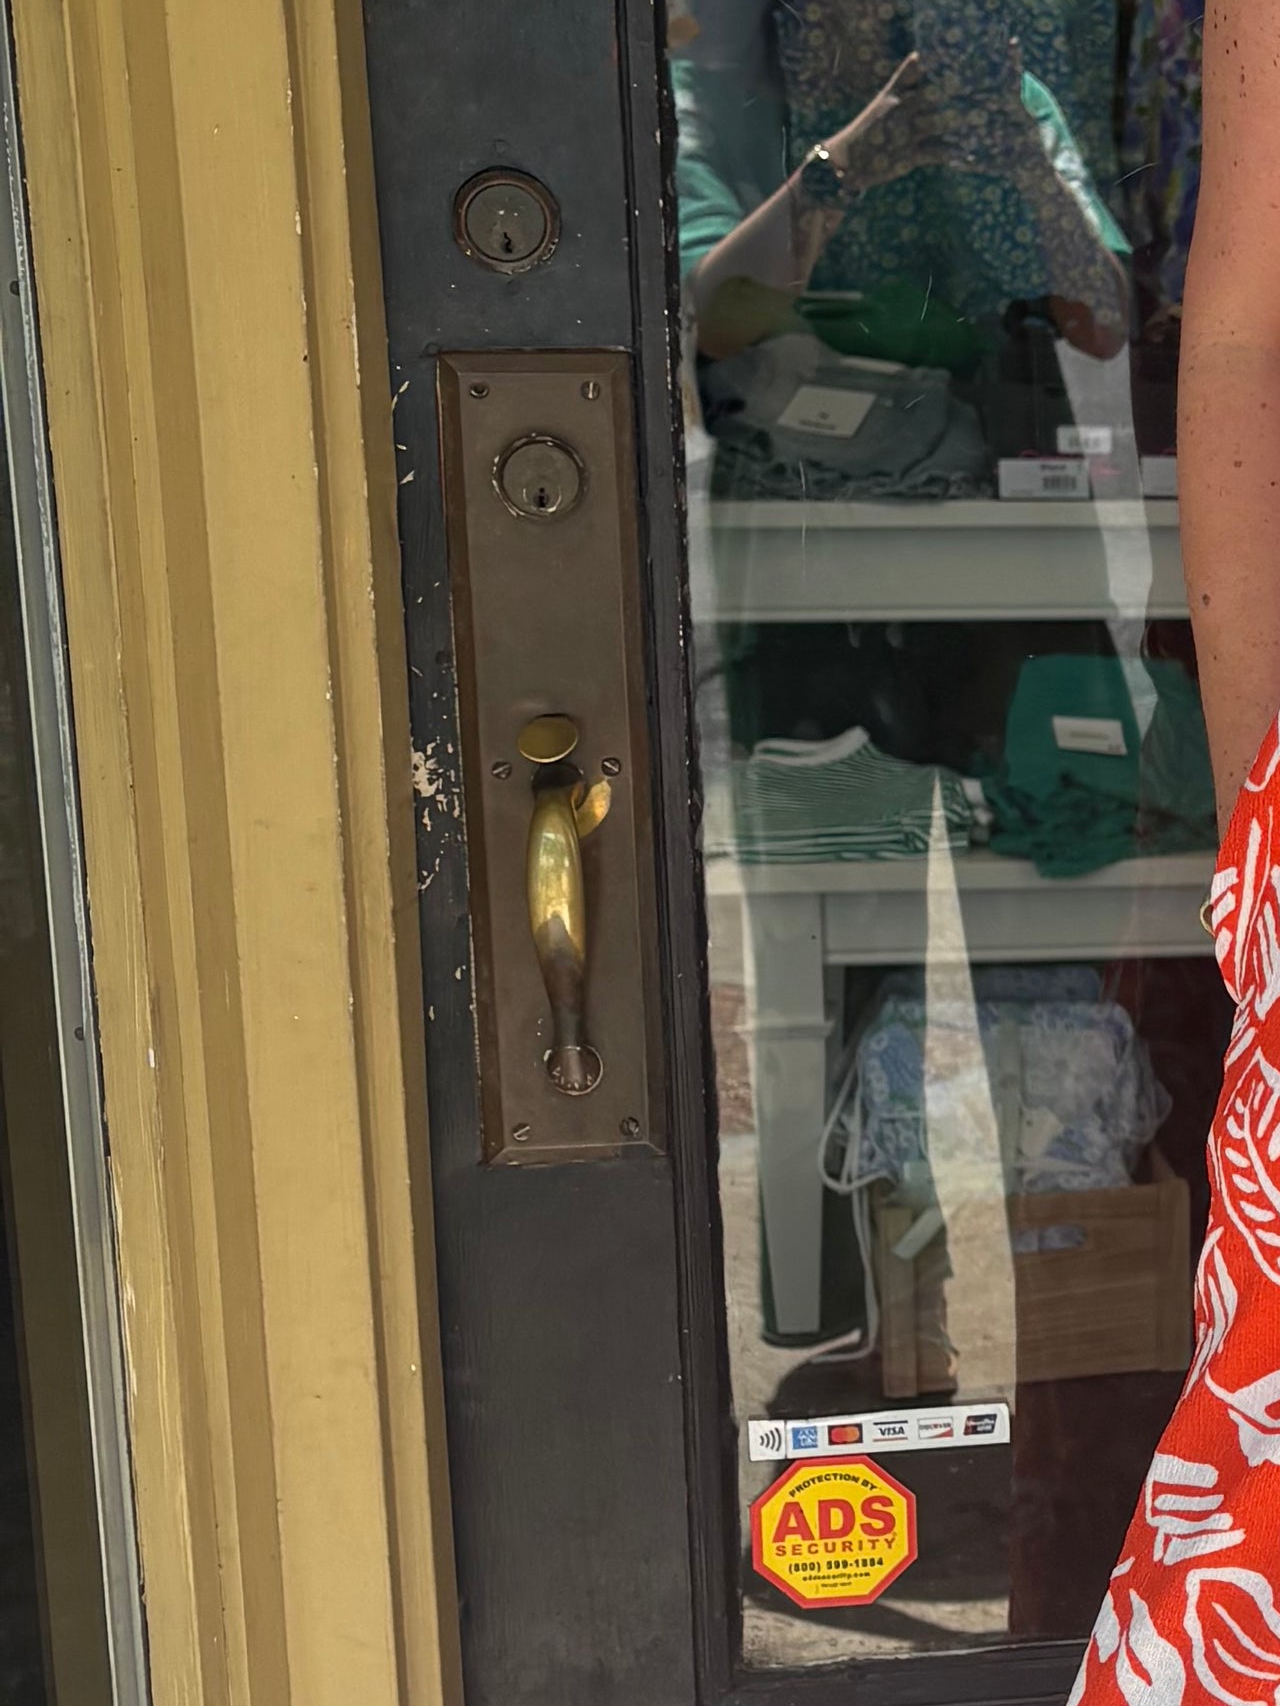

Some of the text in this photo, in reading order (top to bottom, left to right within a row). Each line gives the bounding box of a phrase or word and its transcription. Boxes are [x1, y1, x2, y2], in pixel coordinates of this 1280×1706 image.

[878, 1426, 905, 1437] VISA
[788, 1472, 877, 1498] PROTECTION BY
[772, 1495, 897, 1543] ADS
[775, 1537, 896, 1557] SECURITY
